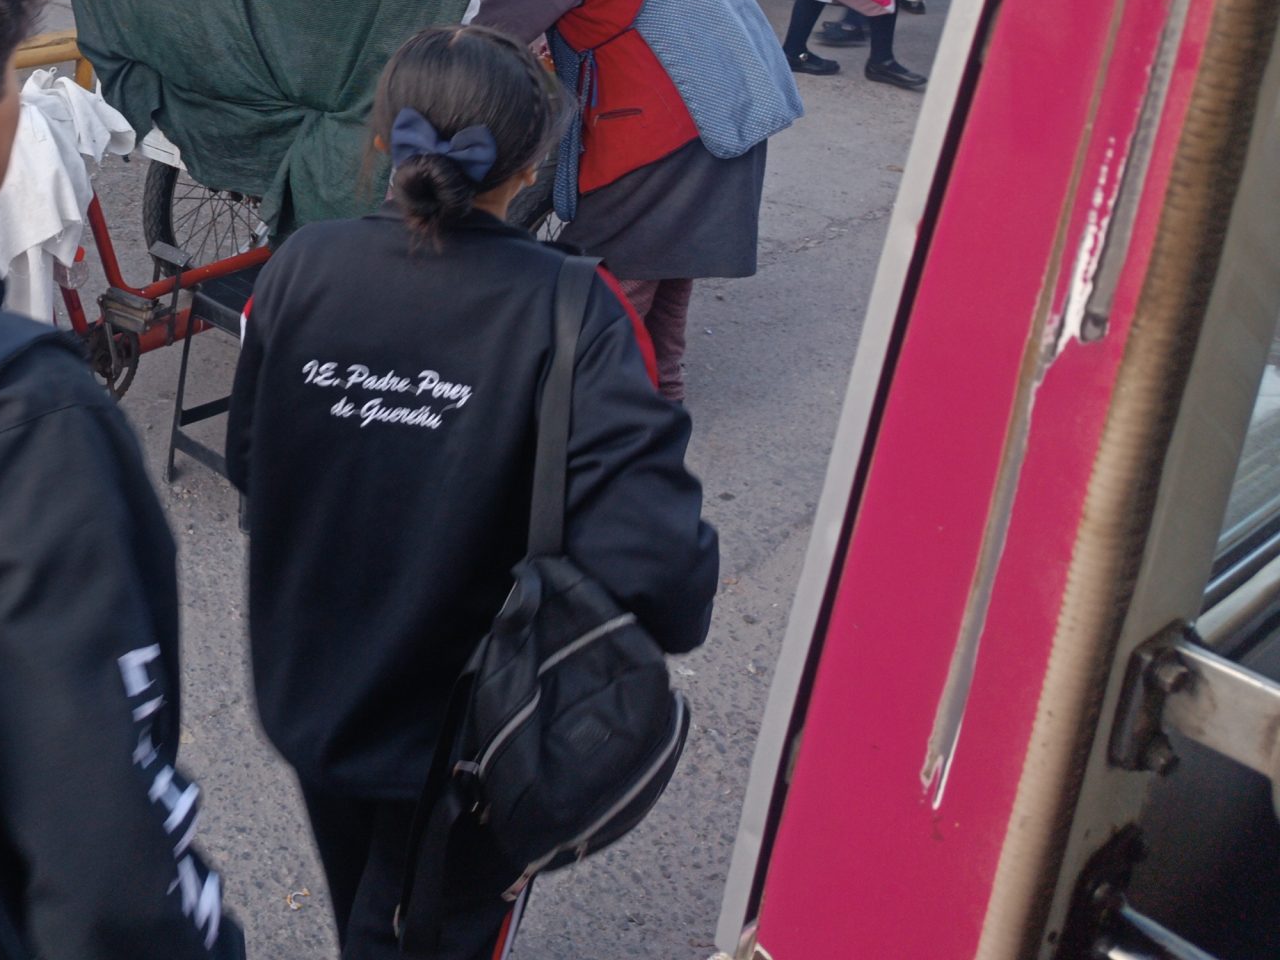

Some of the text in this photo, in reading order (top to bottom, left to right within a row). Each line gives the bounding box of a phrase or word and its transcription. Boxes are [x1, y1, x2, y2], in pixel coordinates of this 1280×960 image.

[345, 363, 412, 393] Padre
[415, 369, 473, 408] Perez
[330, 396, 355, 419] de
